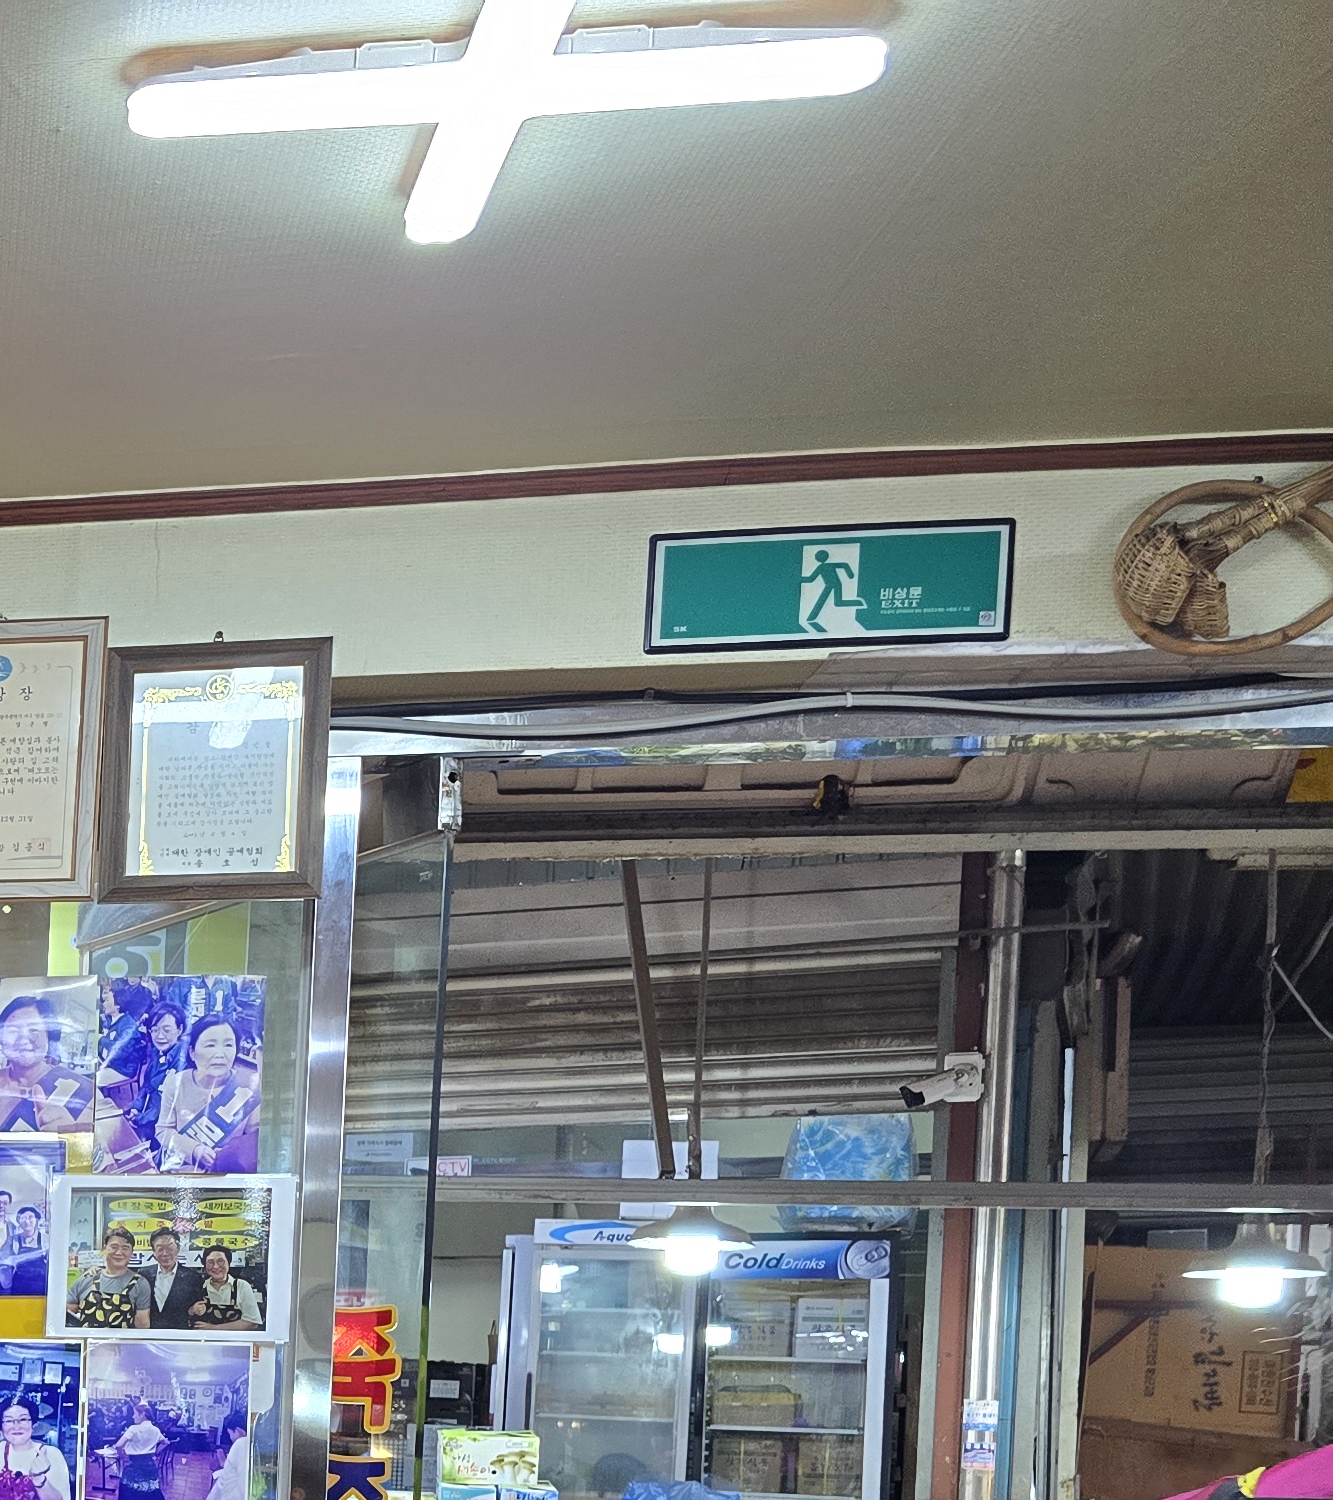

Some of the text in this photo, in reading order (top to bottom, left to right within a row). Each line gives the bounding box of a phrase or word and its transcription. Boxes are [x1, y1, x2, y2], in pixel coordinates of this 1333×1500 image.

[880, 586, 922, 599] 비상문
[881, 599, 920, 608] EXIT
[724, 1252, 826, 1271] Cold Drinks
[332, 1307, 400, 1432] 죽
